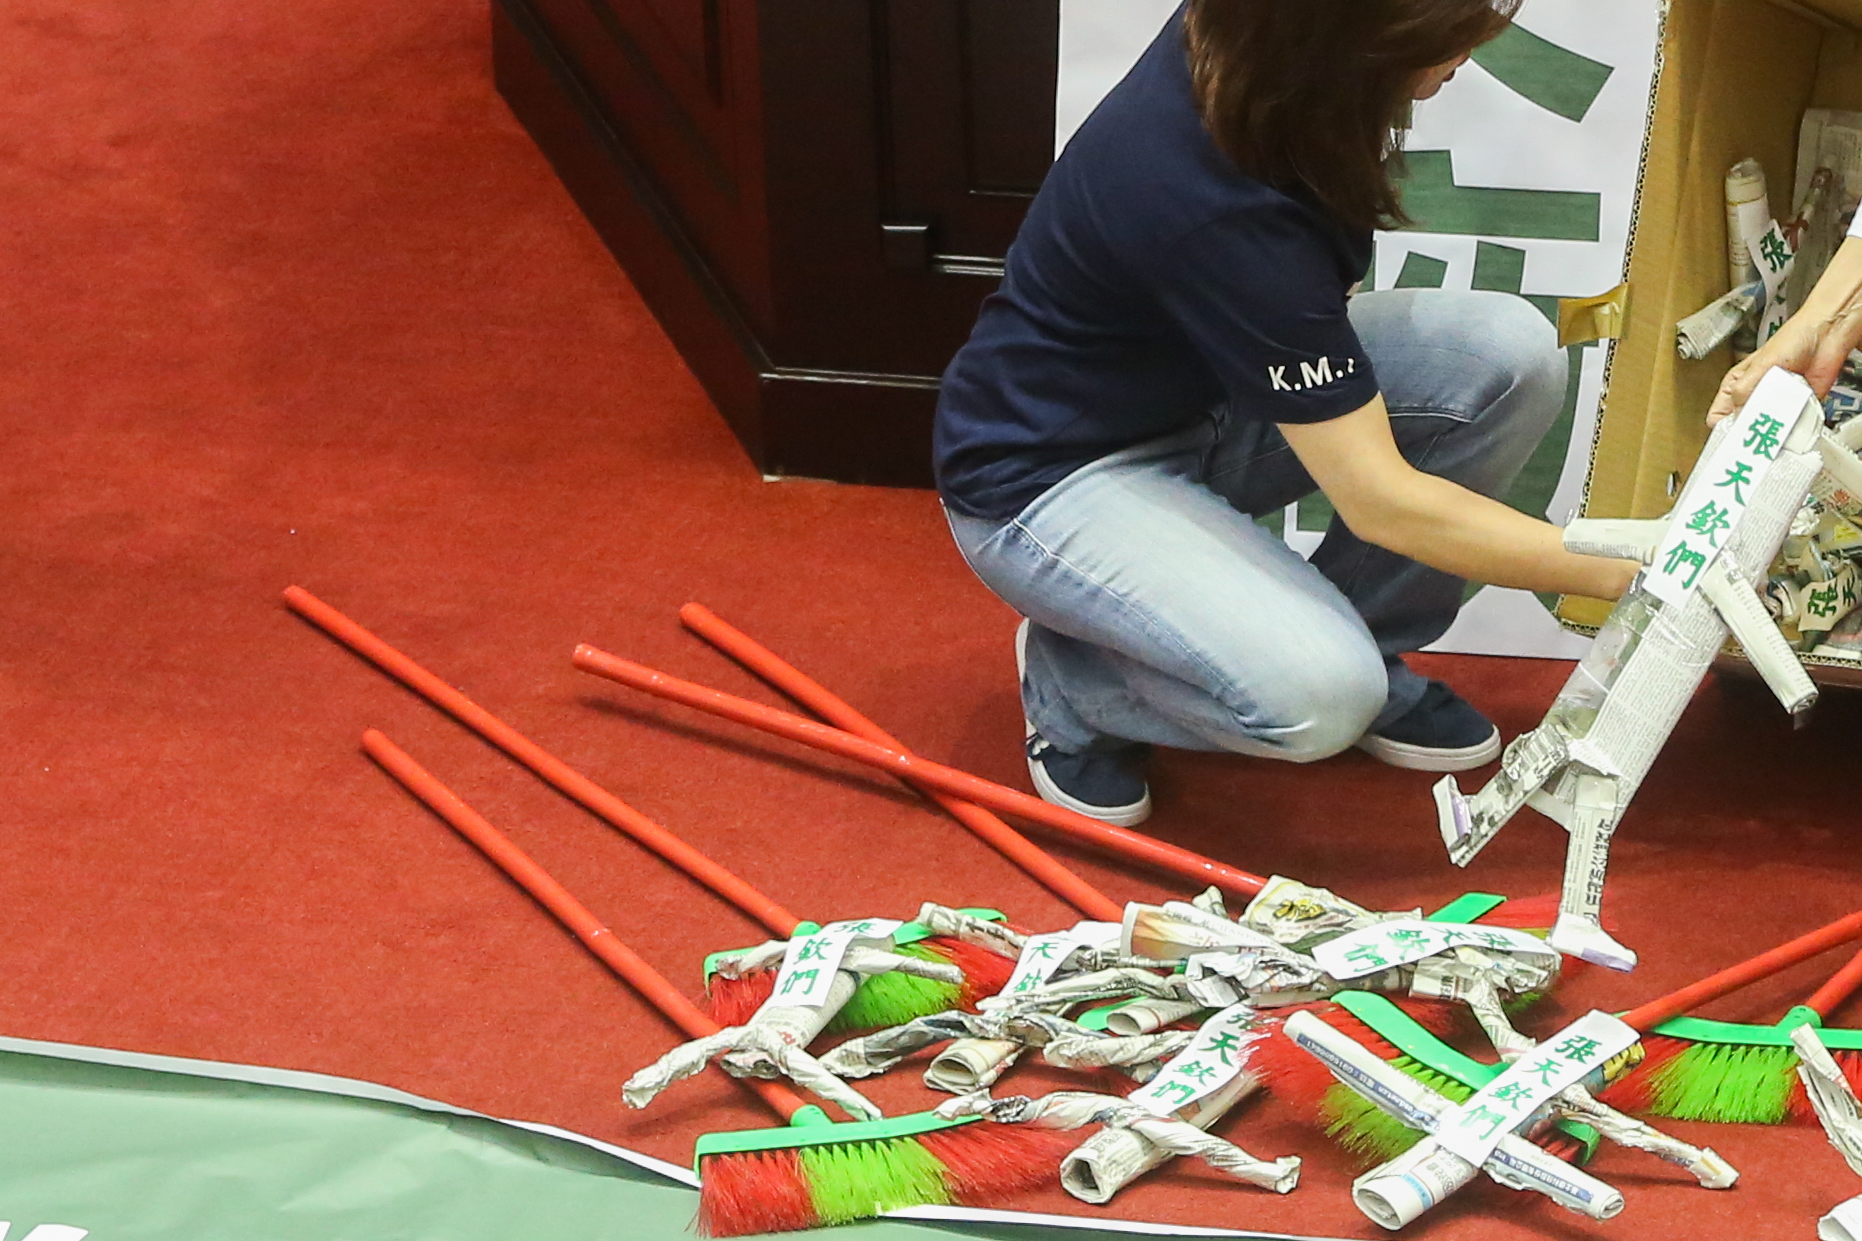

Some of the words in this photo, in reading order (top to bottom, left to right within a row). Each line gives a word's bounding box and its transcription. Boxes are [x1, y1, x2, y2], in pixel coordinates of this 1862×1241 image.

[1662, 412, 1784, 590] 張天欽們
[1459, 1035, 1602, 1140] 張天欽們
